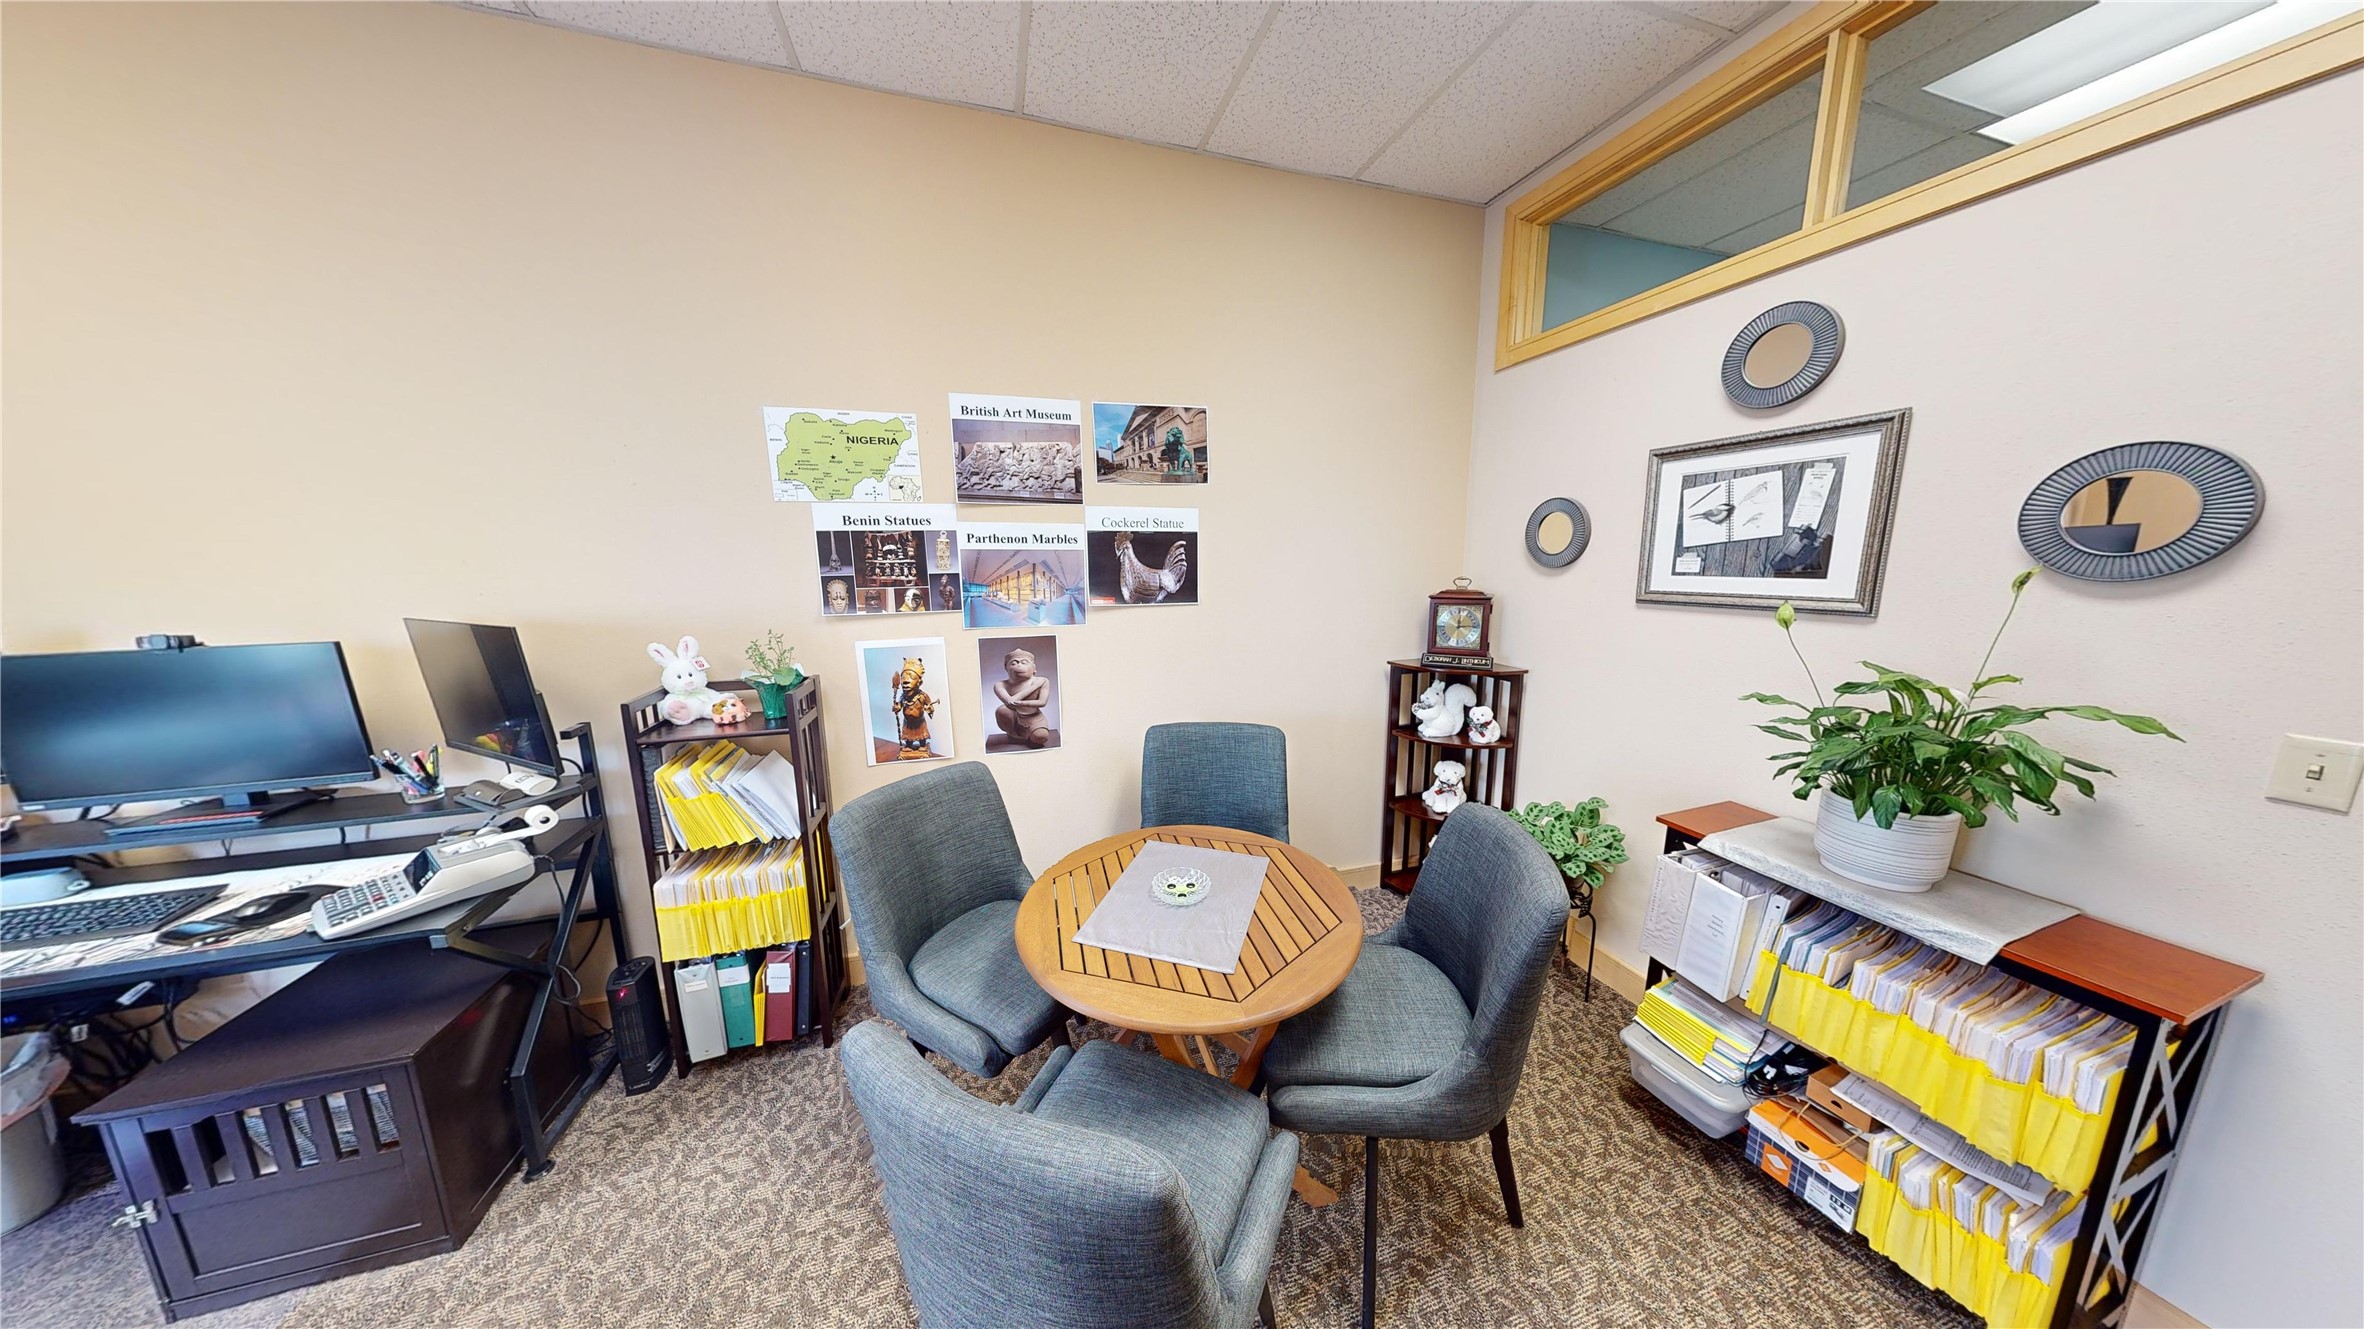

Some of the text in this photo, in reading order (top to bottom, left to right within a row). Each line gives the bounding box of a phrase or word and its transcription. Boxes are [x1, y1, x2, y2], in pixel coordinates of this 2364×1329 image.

[960, 405, 1072, 420] British Art Museum
[846, 435, 899, 446] NIGERIA
[842, 515, 932, 526] Benin Statues
[1101, 517, 1185, 529] Cockerel Statue
[966, 533, 1079, 545] Parthenon Marbles
